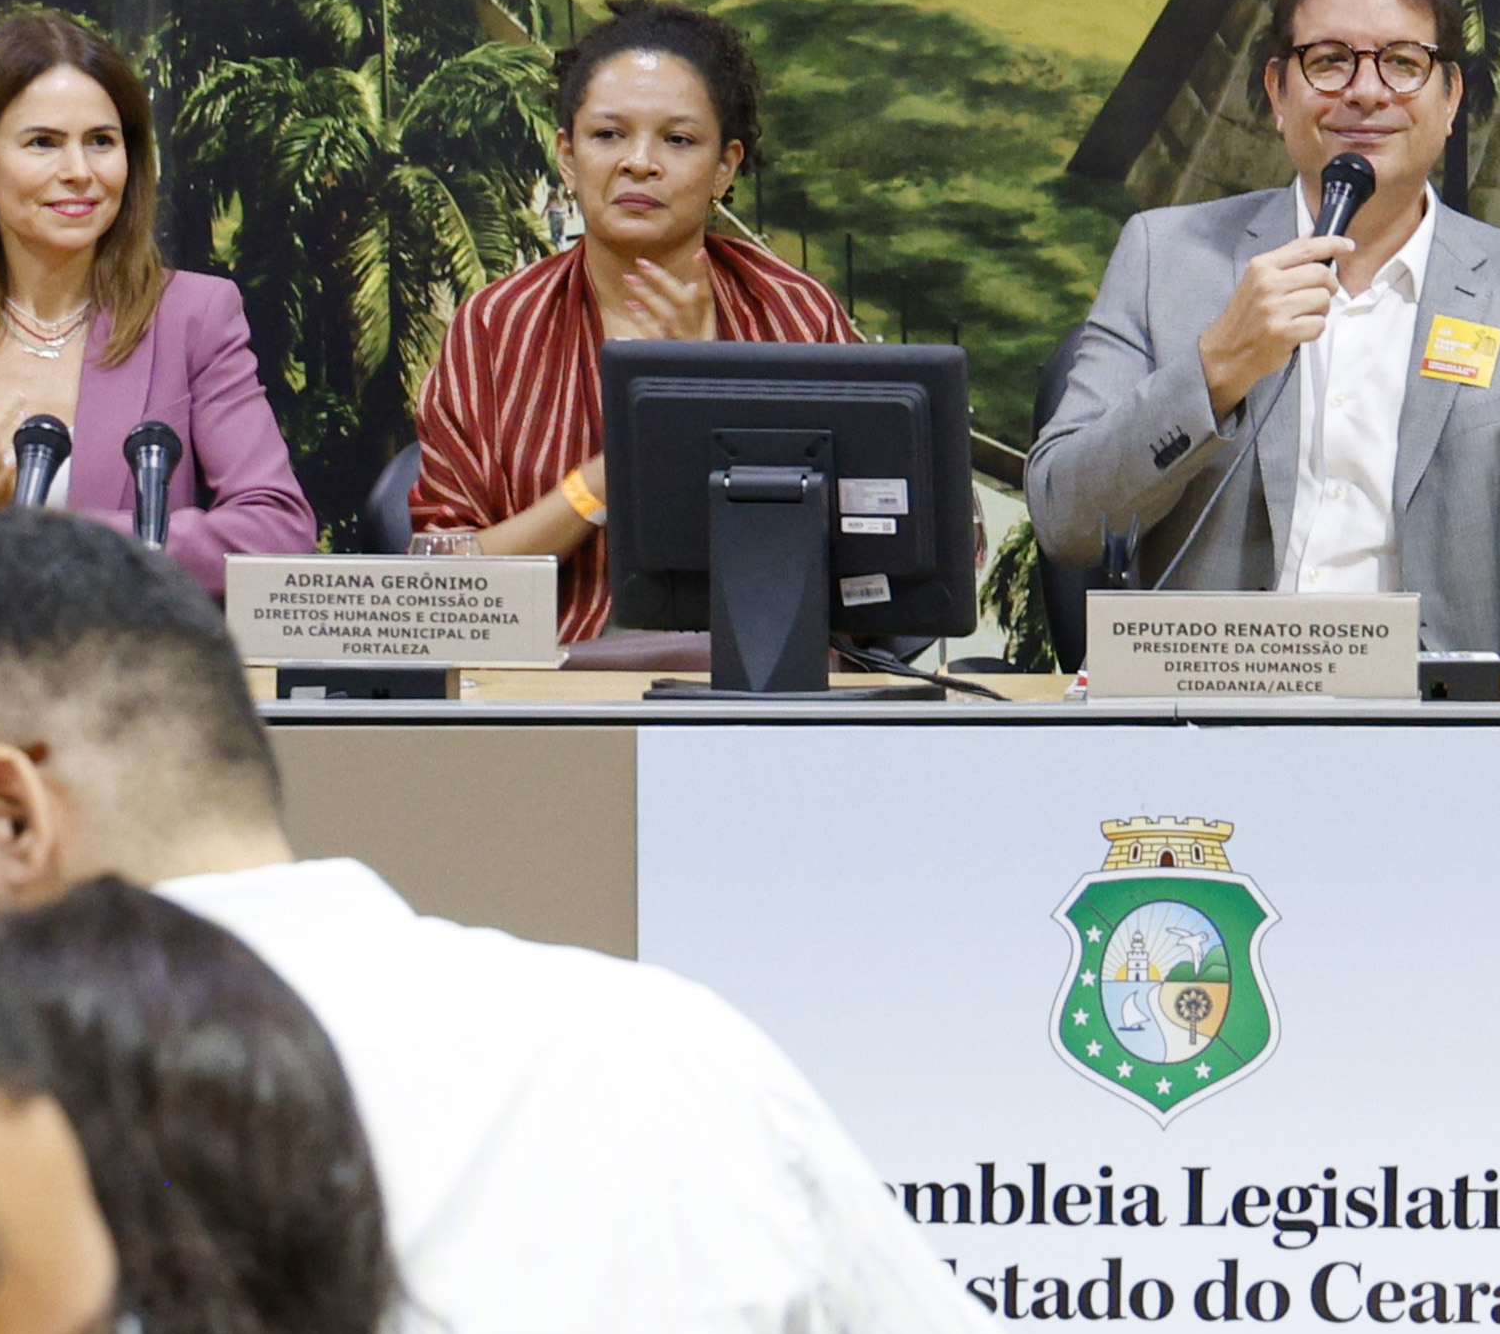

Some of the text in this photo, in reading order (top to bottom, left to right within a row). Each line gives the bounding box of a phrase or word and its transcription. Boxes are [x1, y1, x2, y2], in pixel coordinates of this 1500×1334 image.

[285, 571, 488, 591] ADRIANA GERÔNIMO
[269, 592, 504, 608] PRESIDENTE DA COMISSÃO DE
[253, 608, 520, 624] DIREITOS HUMANOS E CIDADANIA
[282, 623, 491, 640] DA CÂMARA MUNICIPAL DE
[1112, 622, 1390, 638] DEPUTADO RENATO ROSENO
[341, 642, 430, 655] FORTALEZA
[1133, 641, 1369, 655] PRESIDENTE DA COMISSÃO DE
[1164, 661, 1337, 673] DIREITOS HUMANOS E
[1177, 679, 1323, 693] CIDADANIA/ALECE
[1193, 1258, 1291, 1323] do
